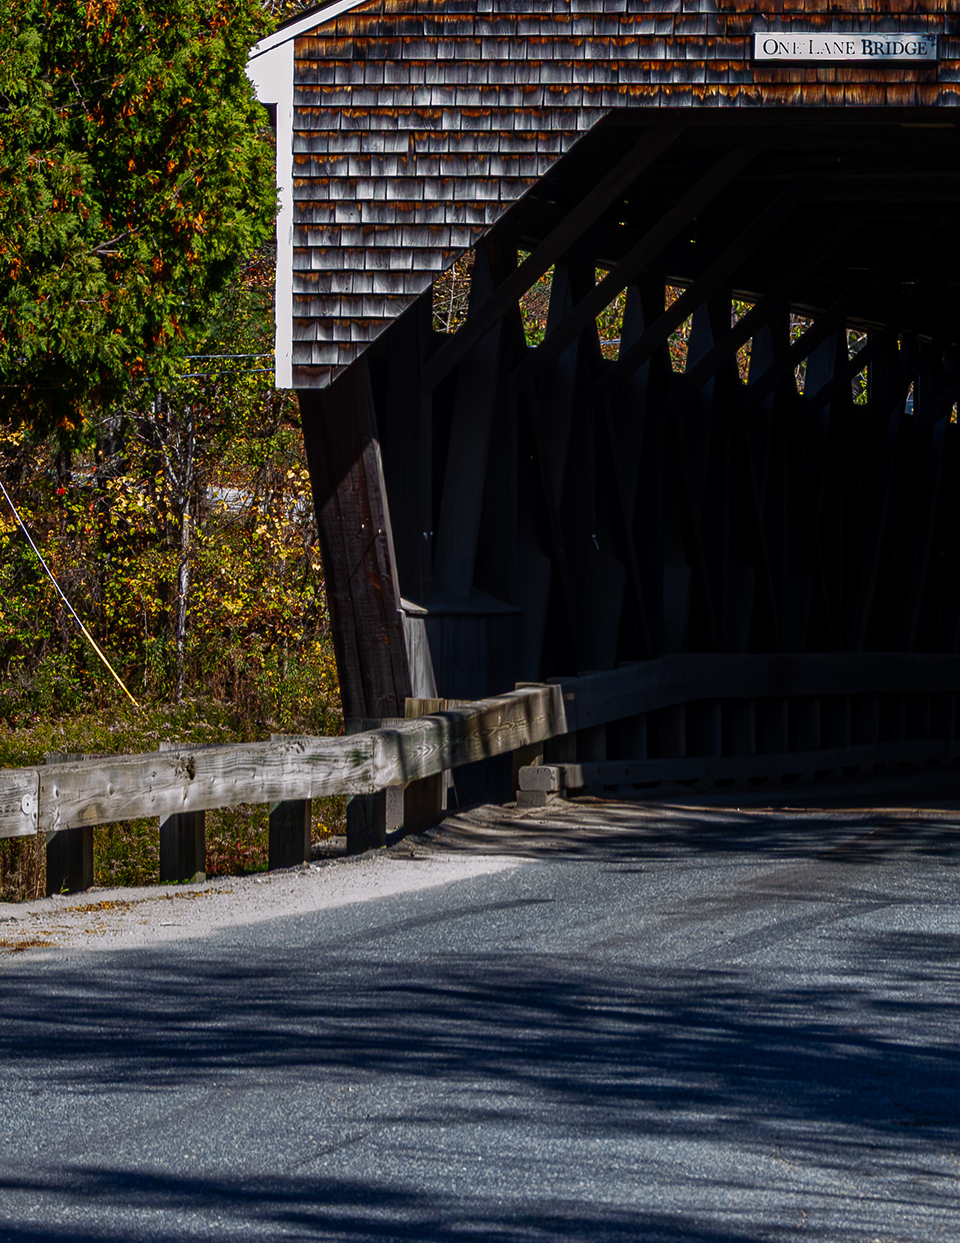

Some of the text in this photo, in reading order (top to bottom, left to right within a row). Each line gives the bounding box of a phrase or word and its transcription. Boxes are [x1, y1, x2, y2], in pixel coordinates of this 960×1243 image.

[763, 38, 928, 56] ONE LANE BRIDGE
